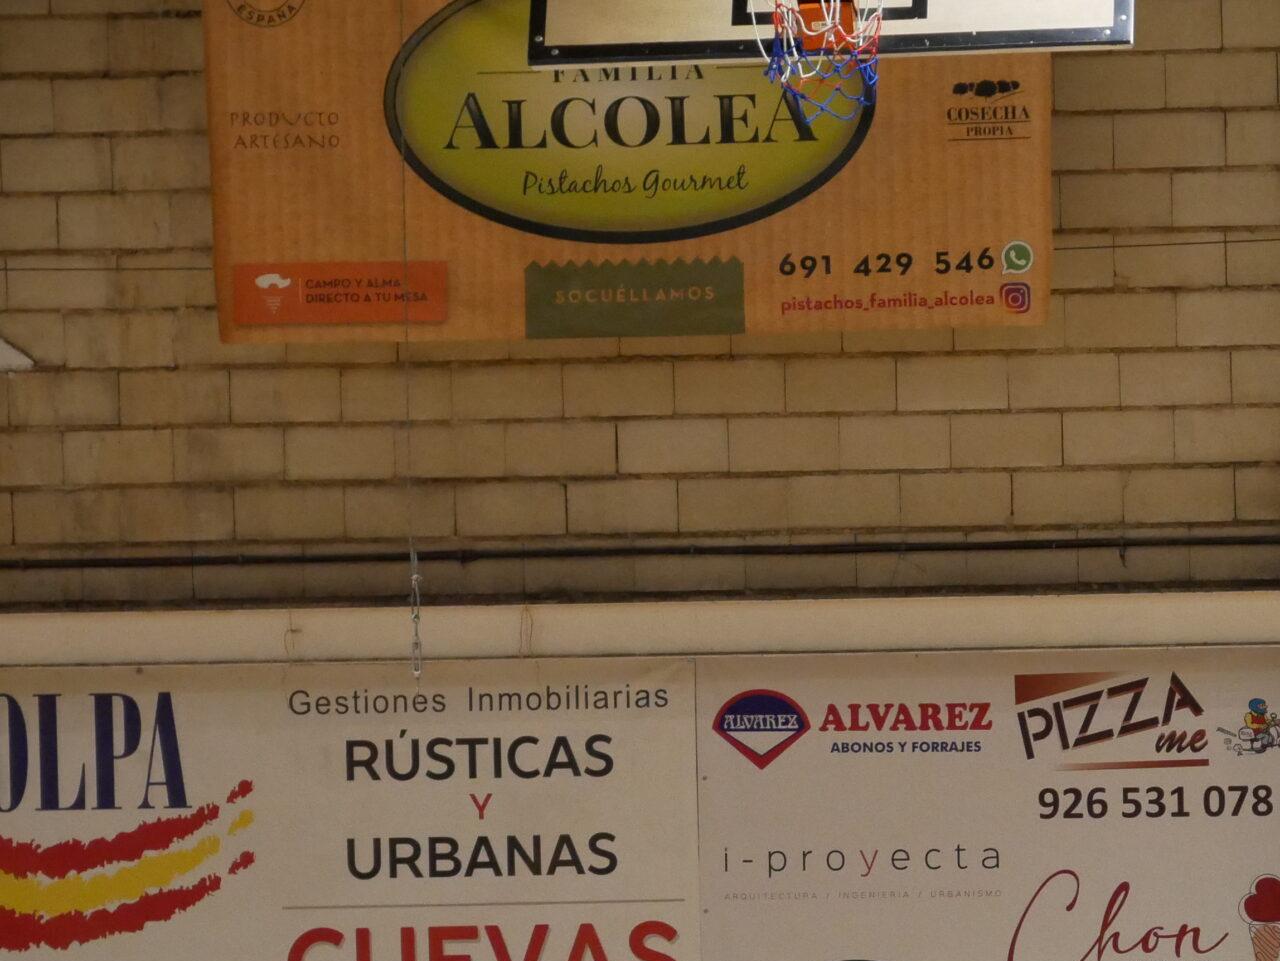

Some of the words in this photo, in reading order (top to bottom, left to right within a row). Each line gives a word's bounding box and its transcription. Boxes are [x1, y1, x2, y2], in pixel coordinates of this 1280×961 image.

[553, 65, 703, 82] FAMILIA
[229, 111, 340, 128] PRODUCTO
[443, 90, 820, 150] ALCOLEA
[946, 106, 1031, 122] COSECHA
[233, 133, 341, 150] ARTESANO
[966, 126, 1013, 137] PROPIA
[522, 164, 636, 197] Pistachos
[642, 164, 748, 200] Gourmet
[779, 253, 832, 278] 691
[853, 252, 913, 277] 429
[934, 247, 994, 275] 546
[305, 279, 350, 290] CAMPO
[355, 279, 362, 289] Y
[366, 278, 401, 288] ALMA
[555, 284, 716, 305] SOCUÉLLAMOS
[305, 293, 360, 304] DIRECTO
[363, 293, 372, 303] A
[375, 292, 391, 303] TU
[394, 292, 428, 303] MESA
[780, 293, 995, 315] pistachos_familia_alcolea
[288, 691, 446, 716] Gestiones
[467, 686, 669, 713] Inmobiliarias
[723, 714, 799, 730] ALVAREZ
[818, 702, 993, 732] ALVAREZ
[1017, 671, 1205, 760] PIZZA
[830, 742, 894, 753] ABONOS
[898, 742, 907, 753] Y
[911, 741, 982, 753] FORRAJES
[1155, 729, 1209, 754] me
[345, 730, 614, 781] RÚSTICAS
[470, 794, 493, 821] Y
[1038, 787, 1108, 819] 926
[1121, 786, 1190, 818] 531
[1203, 785, 1274, 817] 078
[346, 832, 618, 880] URBANAS
